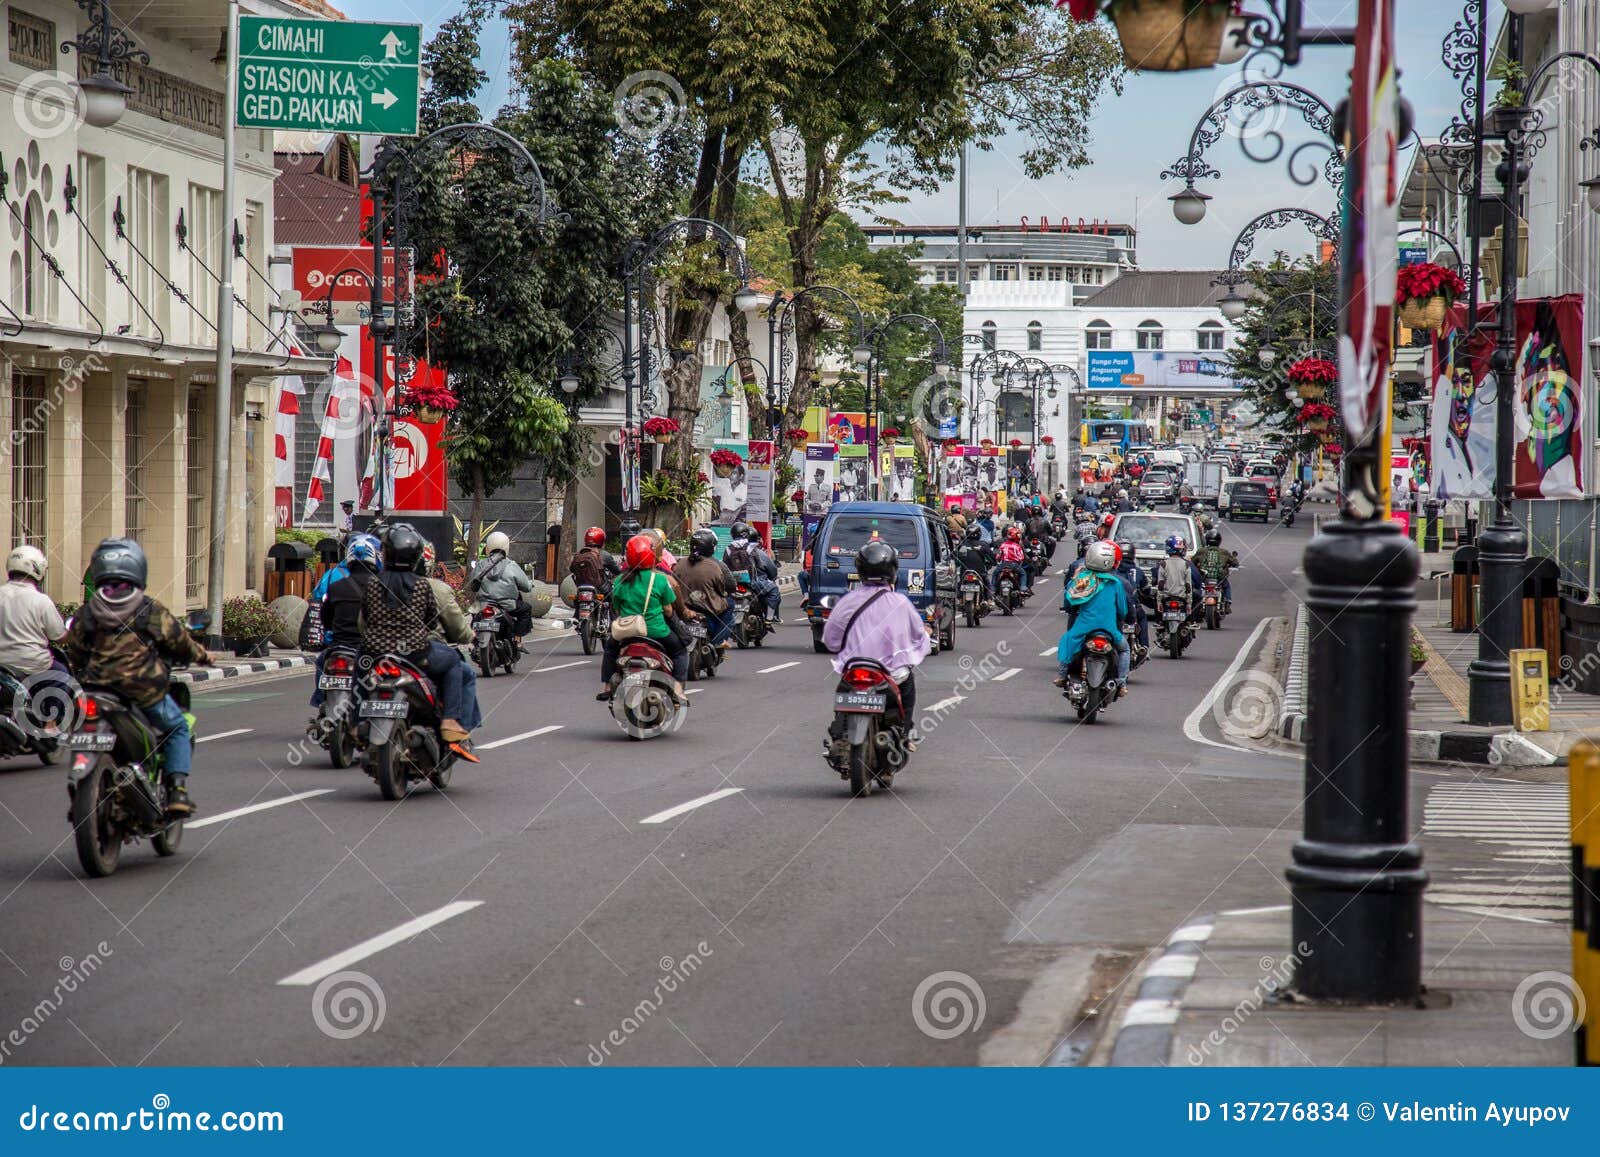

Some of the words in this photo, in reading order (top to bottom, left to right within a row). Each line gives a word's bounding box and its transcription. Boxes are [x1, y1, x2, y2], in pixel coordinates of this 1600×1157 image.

[258, 25, 324, 53] CIMAHI
[243, 65, 325, 94] STASION
[329, 70, 357, 96] KA
[243, 94, 363, 124] GED.PAKUAN
